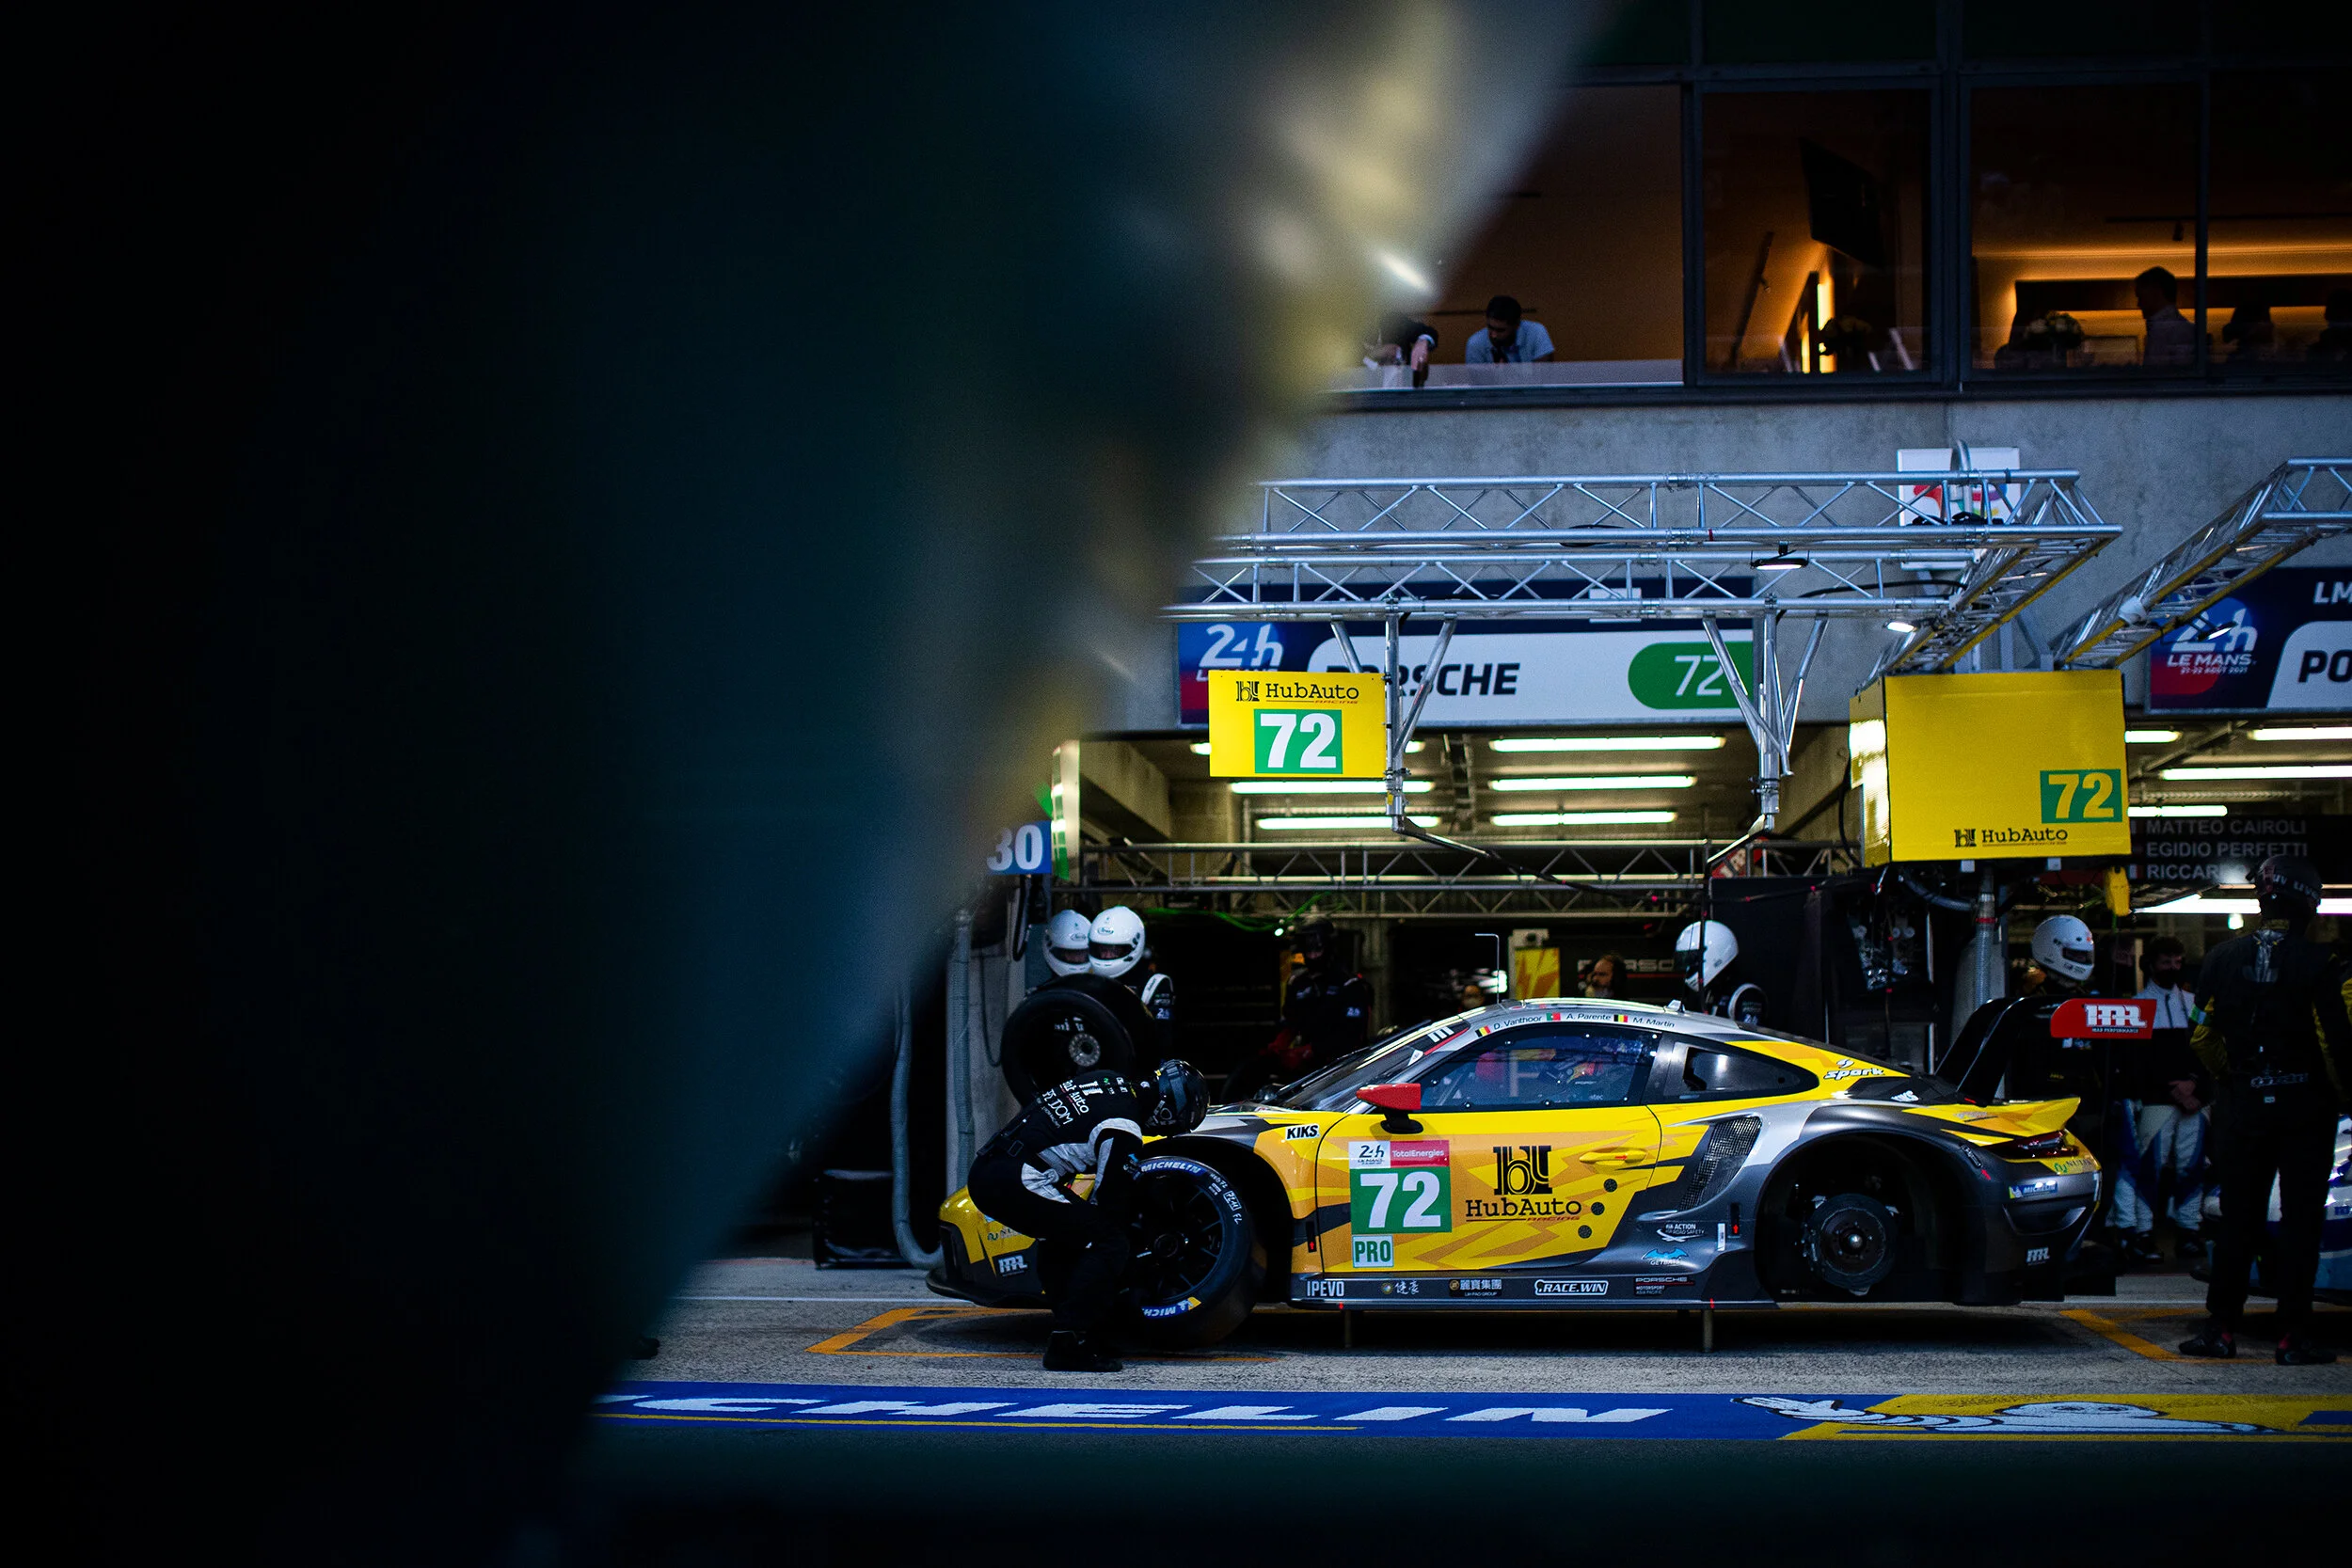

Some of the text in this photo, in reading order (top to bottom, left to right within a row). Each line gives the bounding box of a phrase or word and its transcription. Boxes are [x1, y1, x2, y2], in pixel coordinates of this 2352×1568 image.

[1198, 623, 1284, 668] 24h
[2167, 653, 2252, 668] LE MANS
[1674, 655, 1724, 697] 72
[1265, 682, 1359, 700] HubAuto
[1260, 712, 1337, 769] 72
[2048, 772, 2115, 819] 72
[2145, 819, 2307, 835] MATTEO CAIROLI
[1981, 828, 2069, 843] HubAuto
[986, 824, 1043, 872] 30
[2146, 842, 2309, 858] EGIDIO PERFETTI
[1493, 1016, 1543, 1031] D. Vanthoor
[1578, 1013, 1612, 1022] Parente
[1645, 1018, 1676, 1028] Martin
[1823, 1068, 1885, 1081] spark
[1286, 1124, 1319, 1140] KIKS
[1359, 1144, 1385, 1159] 24h
[1391, 1148, 1445, 1159] TotalEnergies
[1140, 1160, 1201, 1174] MICHELIN
[1359, 1171, 1441, 1228] 72
[1465, 1197, 1582, 1217] HubAuto
[1354, 1240, 1391, 1263] PRO
[1306, 1280, 1345, 1297] IPEVO
[1141, 1306, 1177, 1317] MICH
